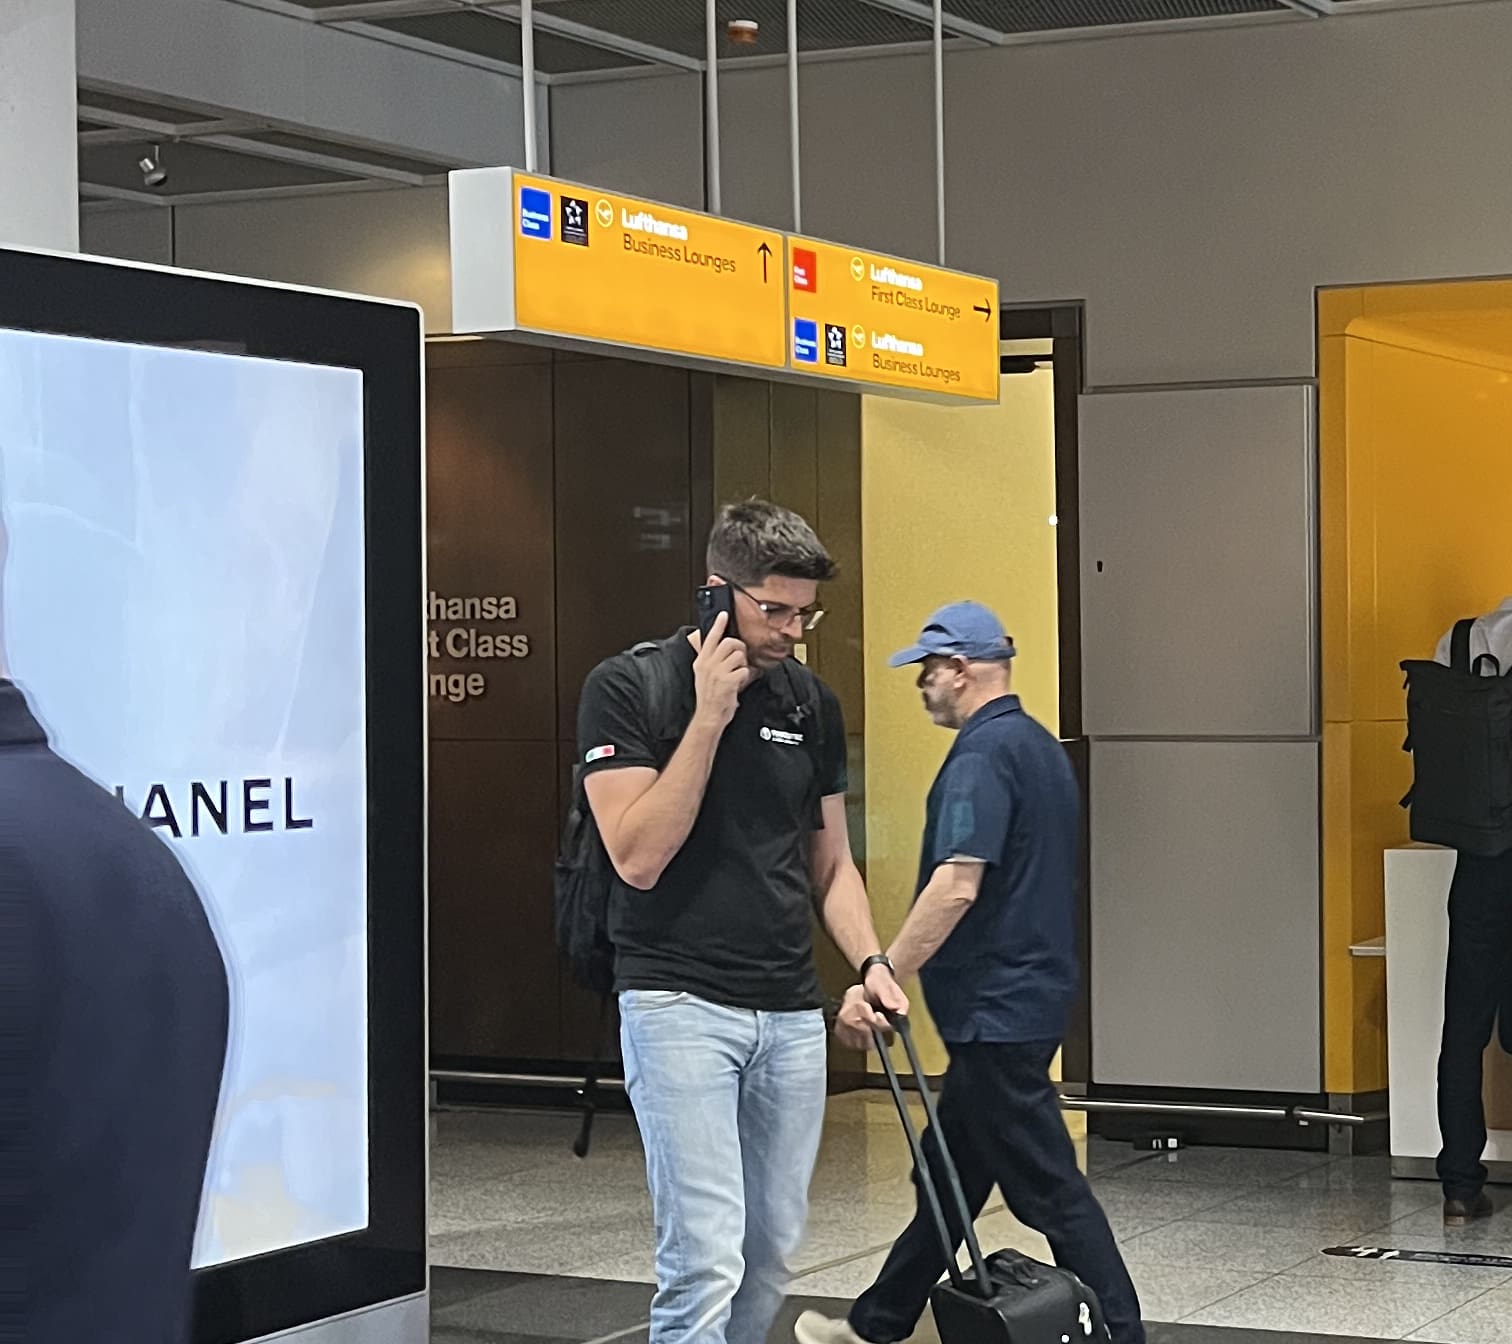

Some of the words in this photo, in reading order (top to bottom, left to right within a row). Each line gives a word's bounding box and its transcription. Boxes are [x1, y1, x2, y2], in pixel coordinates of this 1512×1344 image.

[624, 233, 681, 261] Business
[684, 245, 736, 273] Lounges
[871, 286, 894, 305] First
[896, 291, 923, 311] Class
[925, 297, 961, 320] Lounge
[872, 353, 918, 376] Business
[920, 360, 961, 384] Lounges
[428, 591, 517, 620] hansa
[446, 627, 529, 658] Class
[430, 673, 485, 702] nge
[115, 777, 313, 838] ANEL
